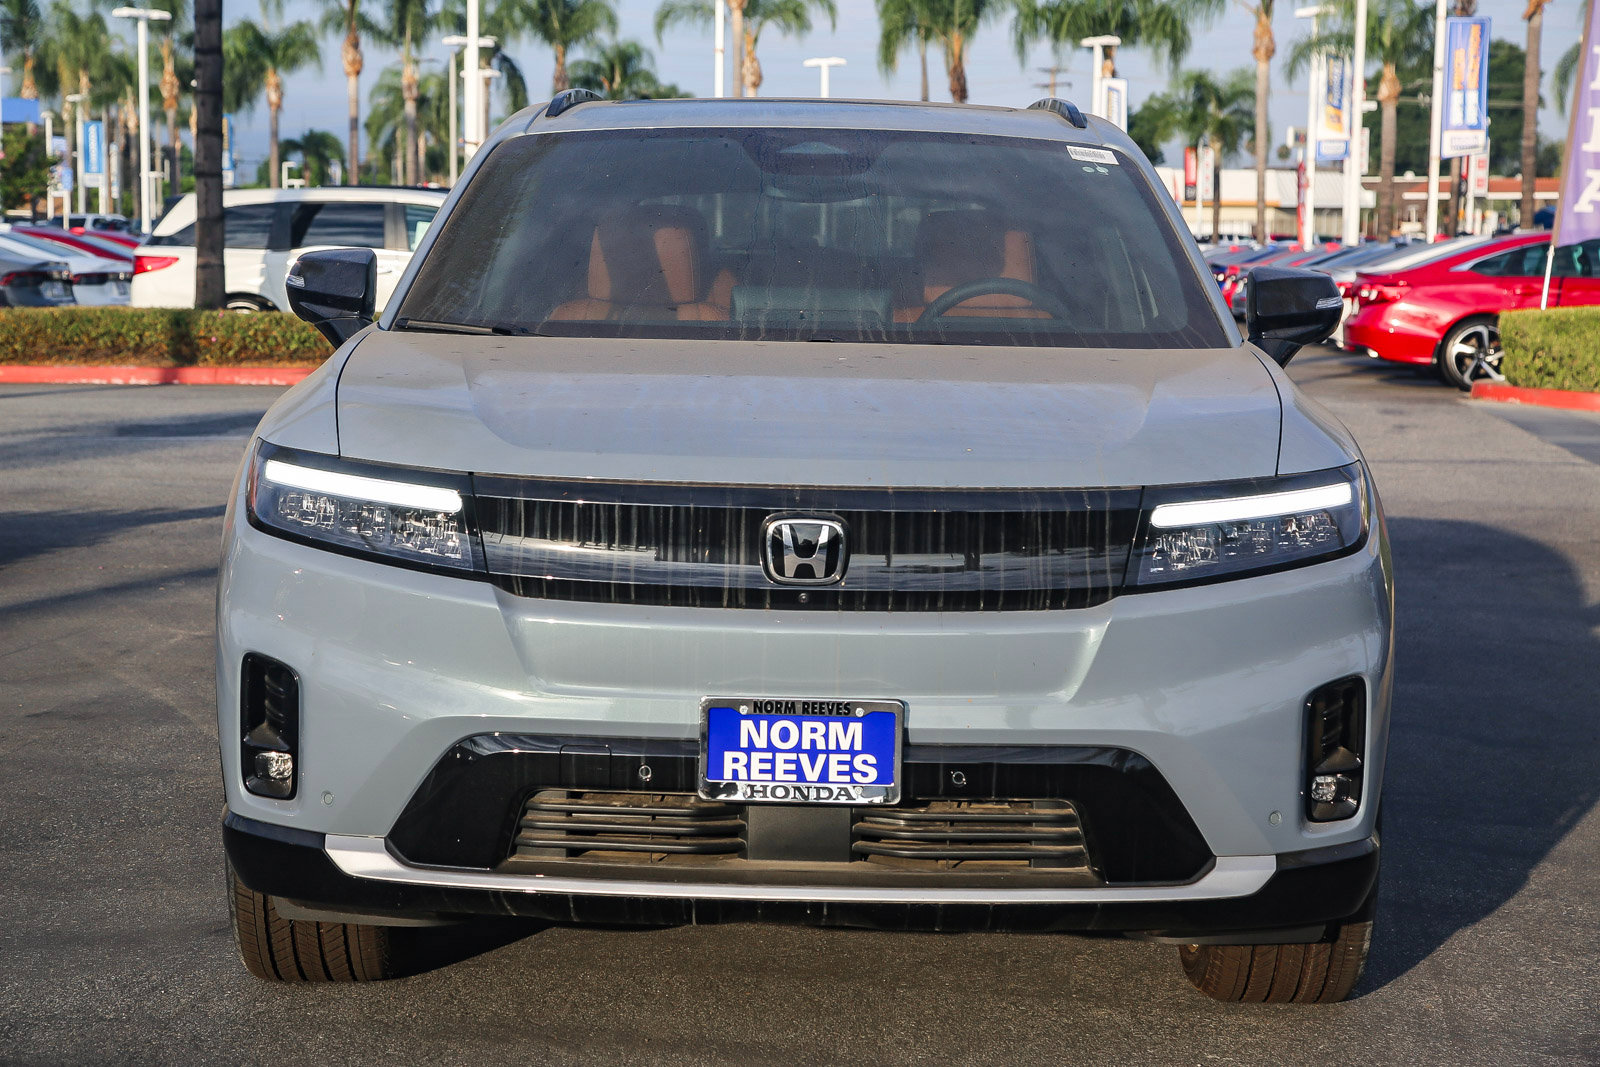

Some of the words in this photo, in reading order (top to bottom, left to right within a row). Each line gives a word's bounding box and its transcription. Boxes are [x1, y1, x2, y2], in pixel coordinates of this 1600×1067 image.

[753, 700, 797, 715] NORM
[801, 702, 852, 716] REEVES
[739, 719, 863, 751] NORM
[723, 750, 878, 784] REEVES
[747, 784, 857, 801] HONDA
